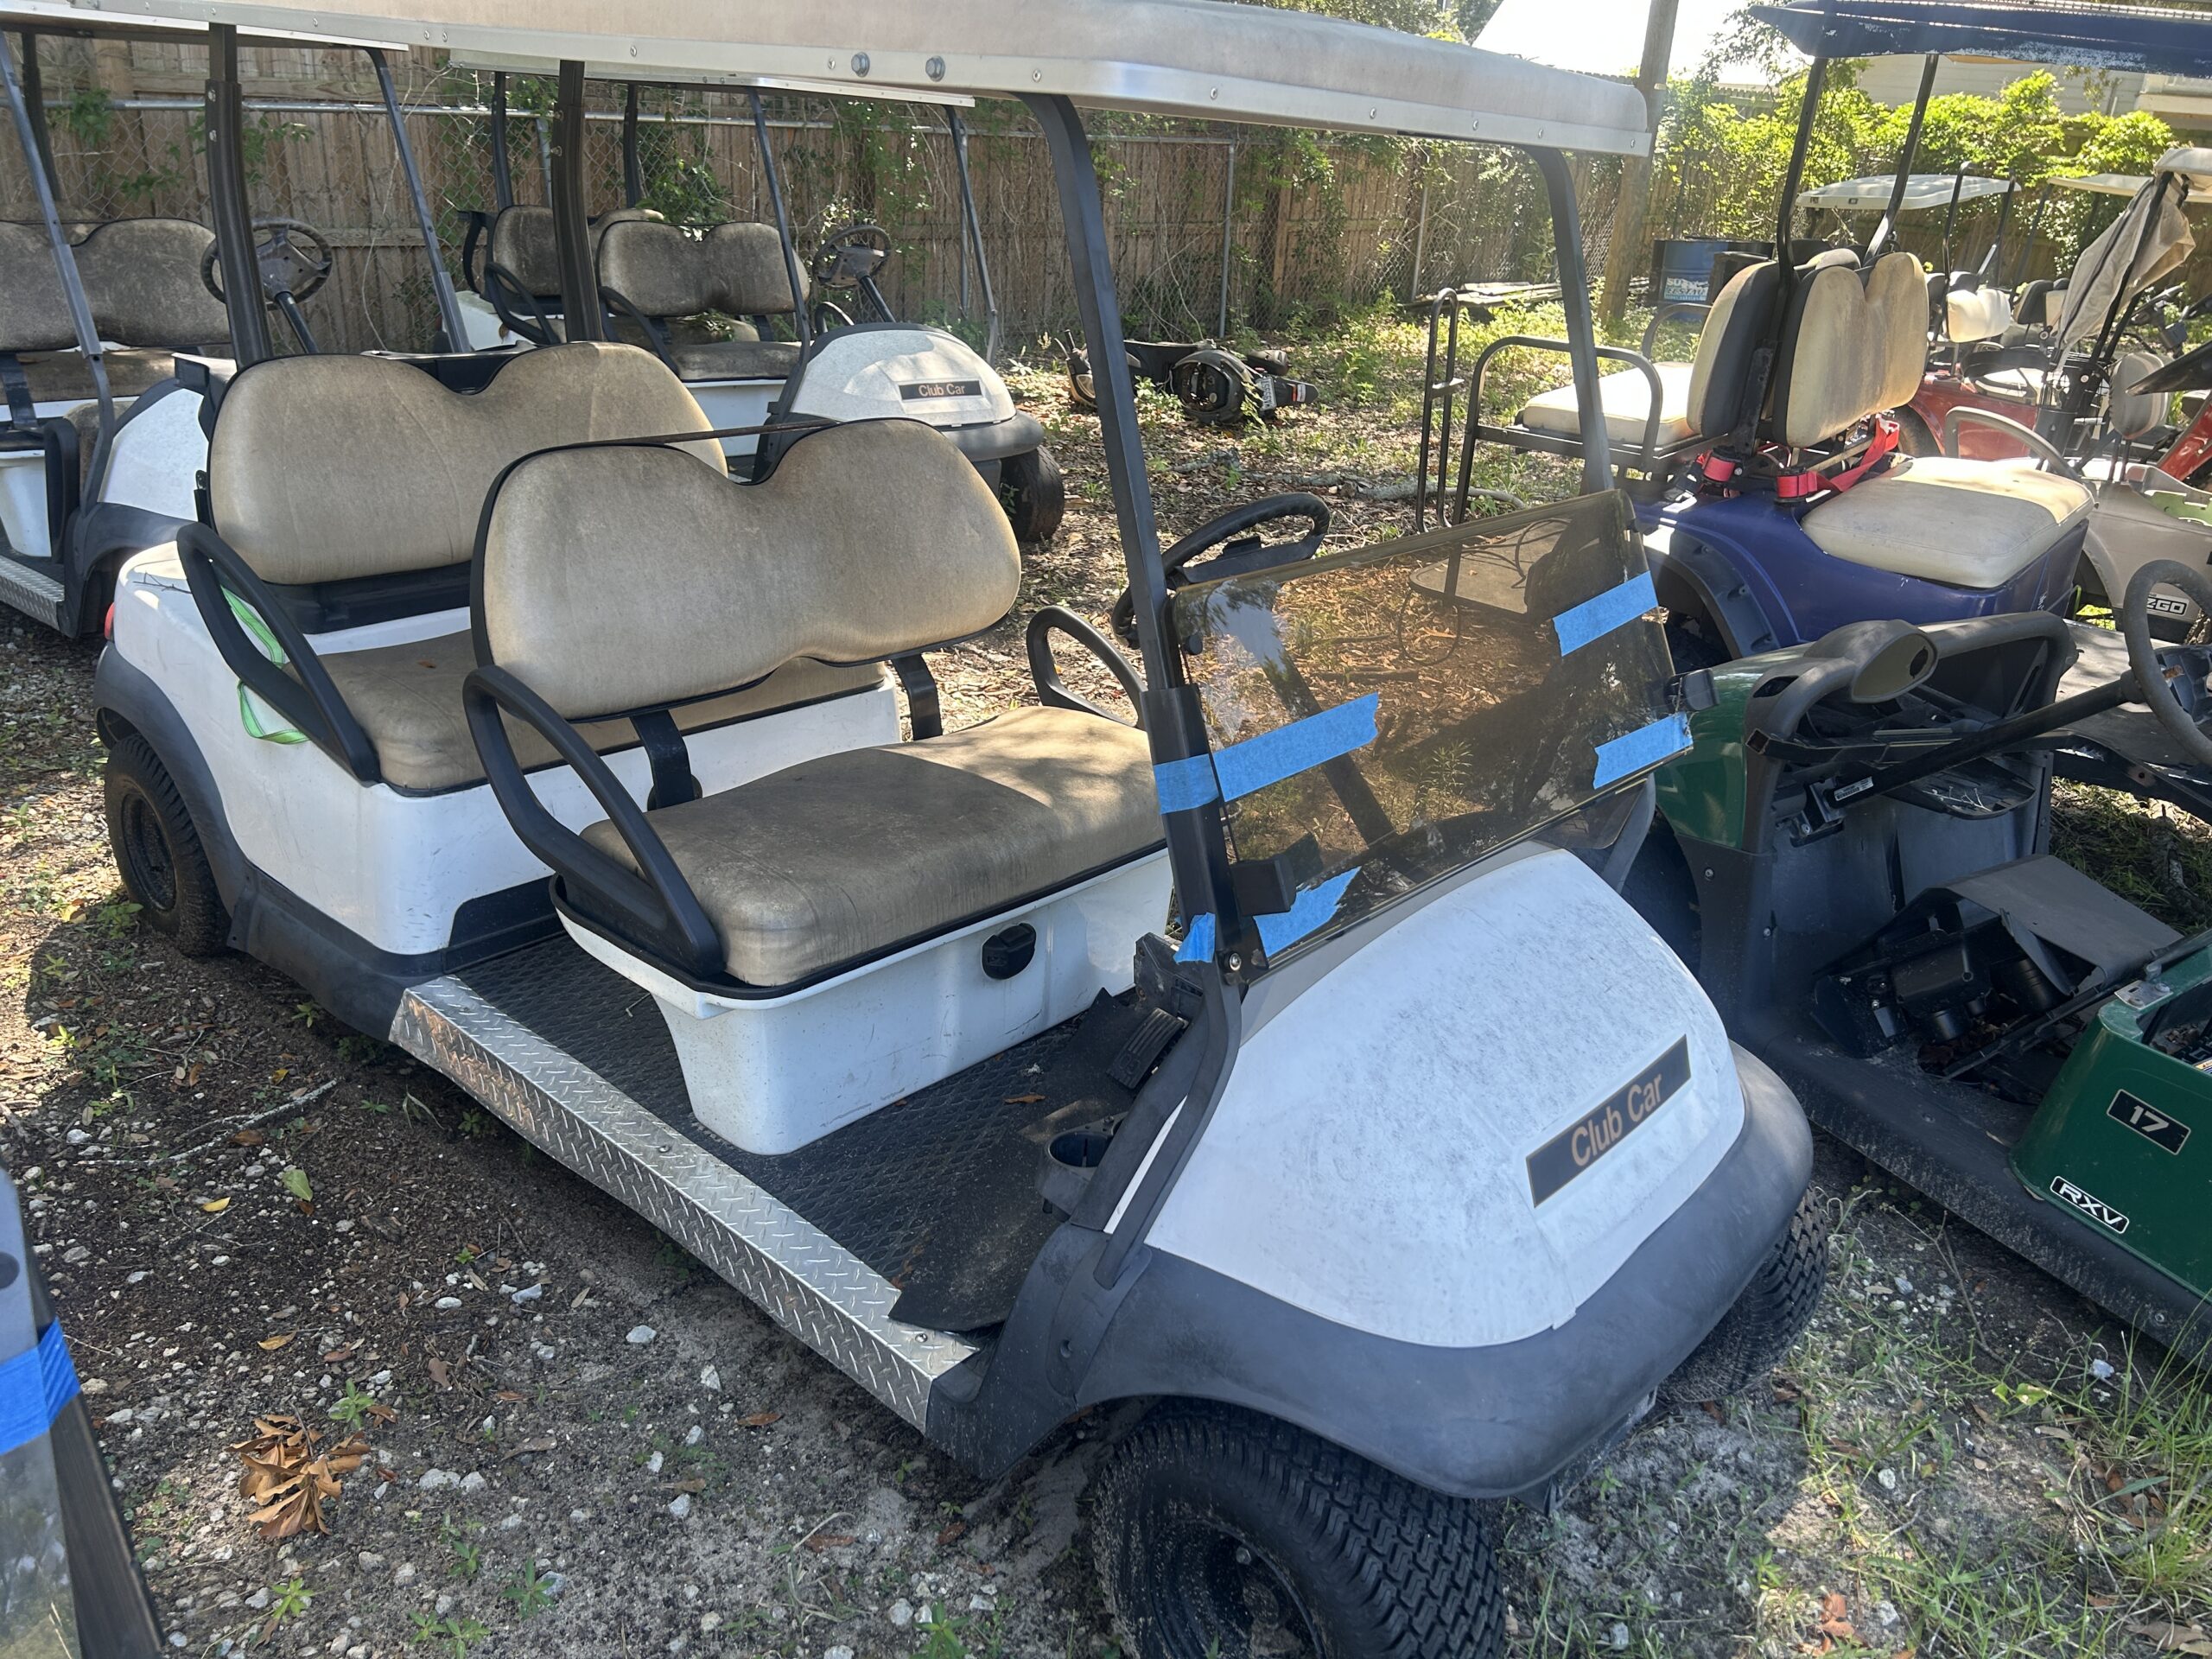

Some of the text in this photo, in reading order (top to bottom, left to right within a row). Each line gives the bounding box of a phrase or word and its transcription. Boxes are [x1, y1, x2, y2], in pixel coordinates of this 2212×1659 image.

[918, 383, 965, 397] Club Car
[1571, 1073, 1662, 1166] Club Car
[2129, 1105, 2170, 1133] 17
[2059, 1182, 2124, 1225] RXV
